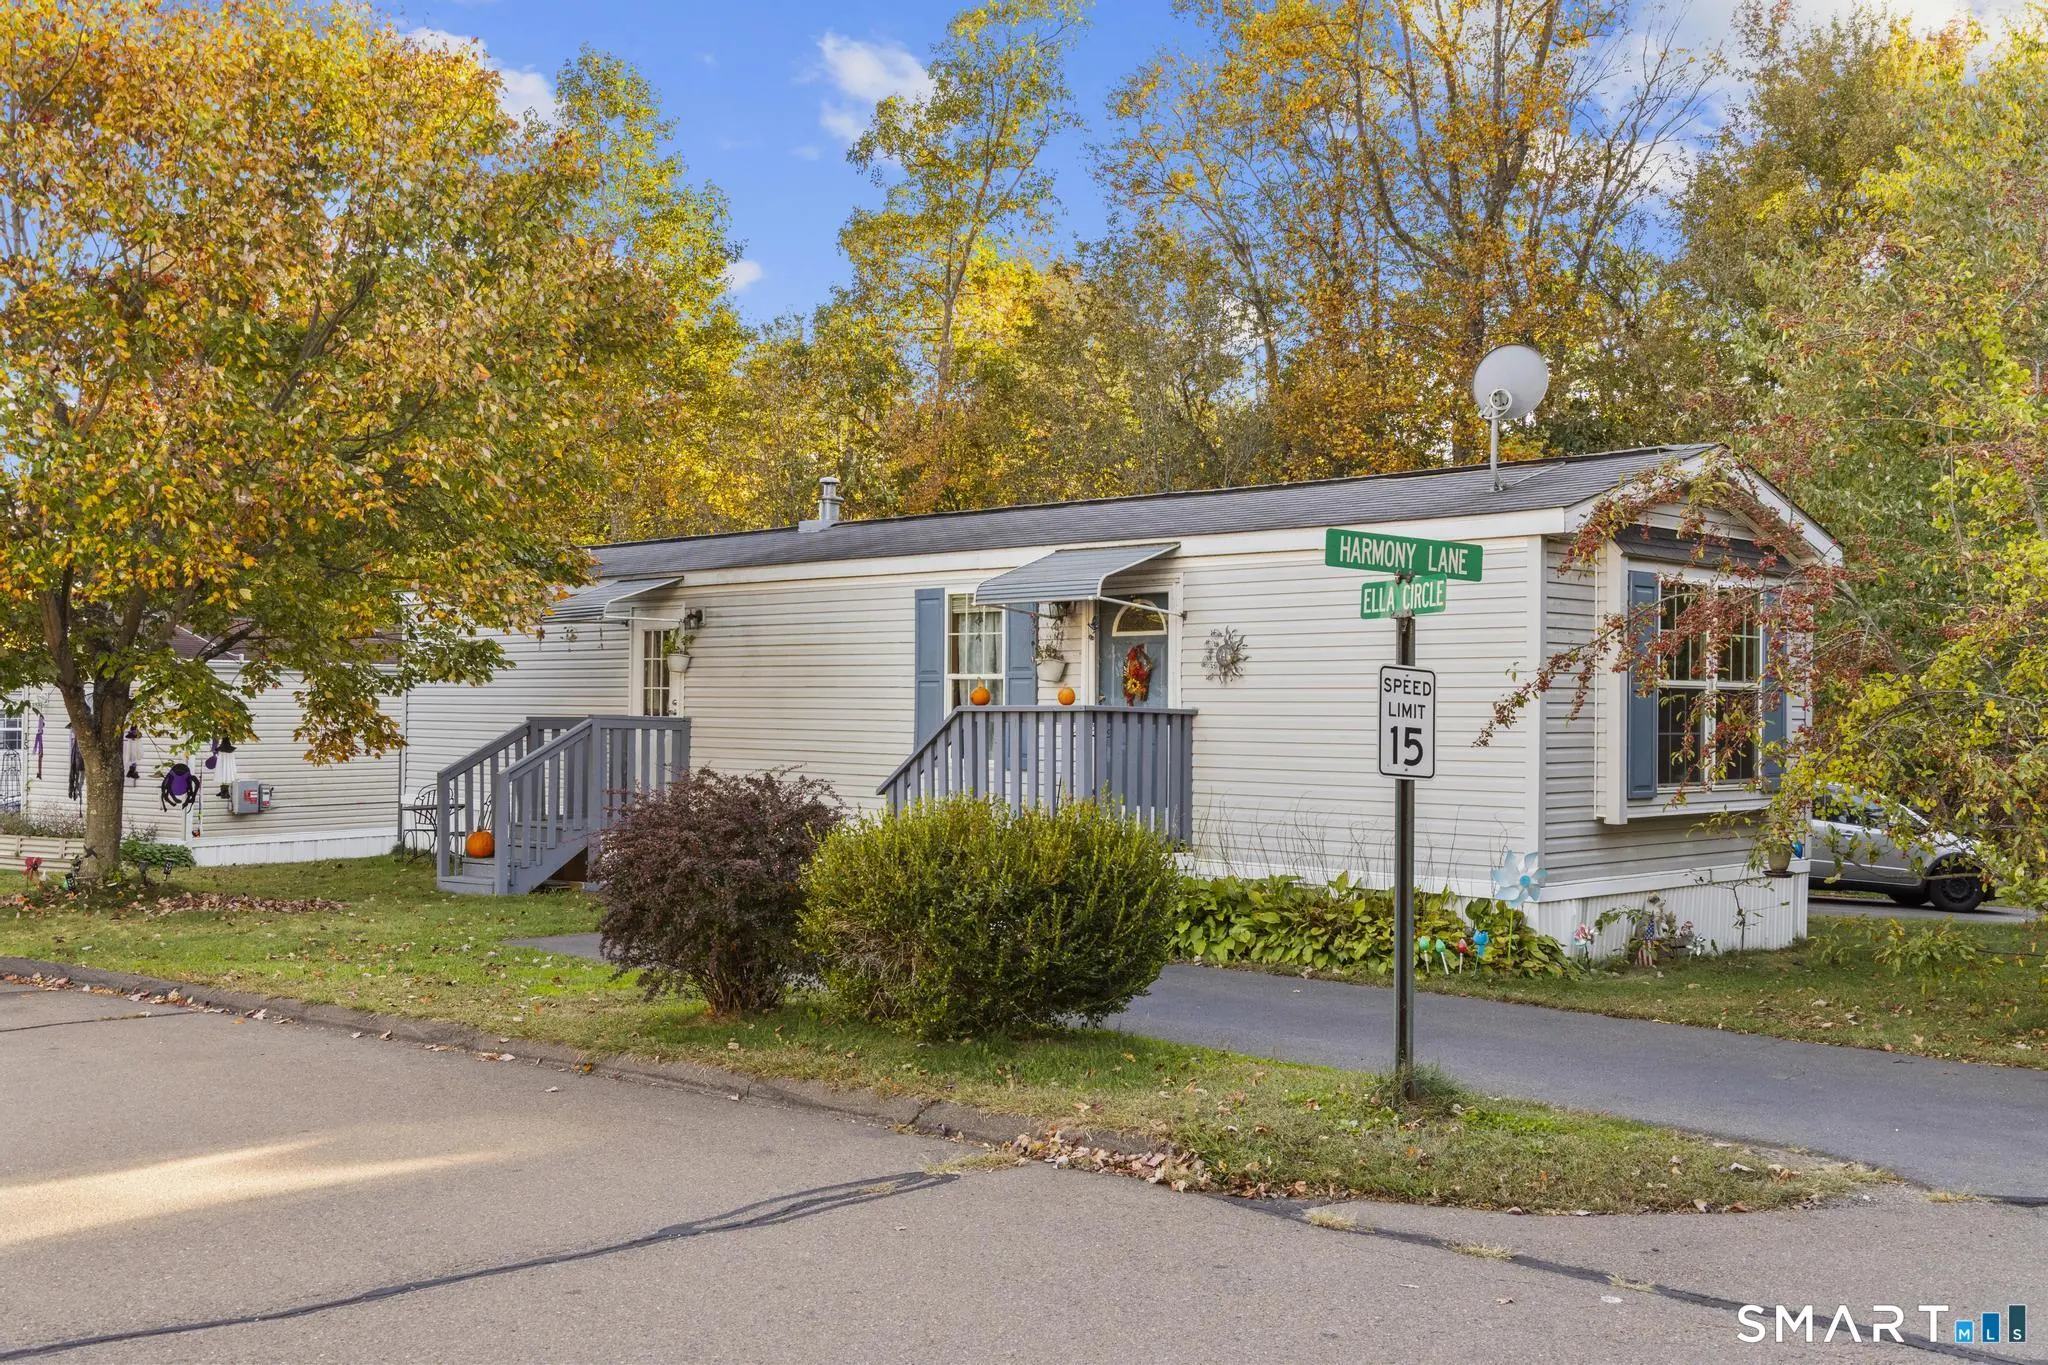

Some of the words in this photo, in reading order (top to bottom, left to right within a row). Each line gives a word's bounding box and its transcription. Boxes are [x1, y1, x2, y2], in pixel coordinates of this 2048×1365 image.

[1339, 535, 1417, 569] HARMONY
[1428, 545, 1468, 575] LANE
[1363, 587, 1395, 613] ELLA
[1402, 580, 1445, 610] CIRCLE
[1384, 677, 1432, 696] SPEED
[1388, 702, 1426, 719] LIMIT
[1390, 726, 1423, 766] 15
